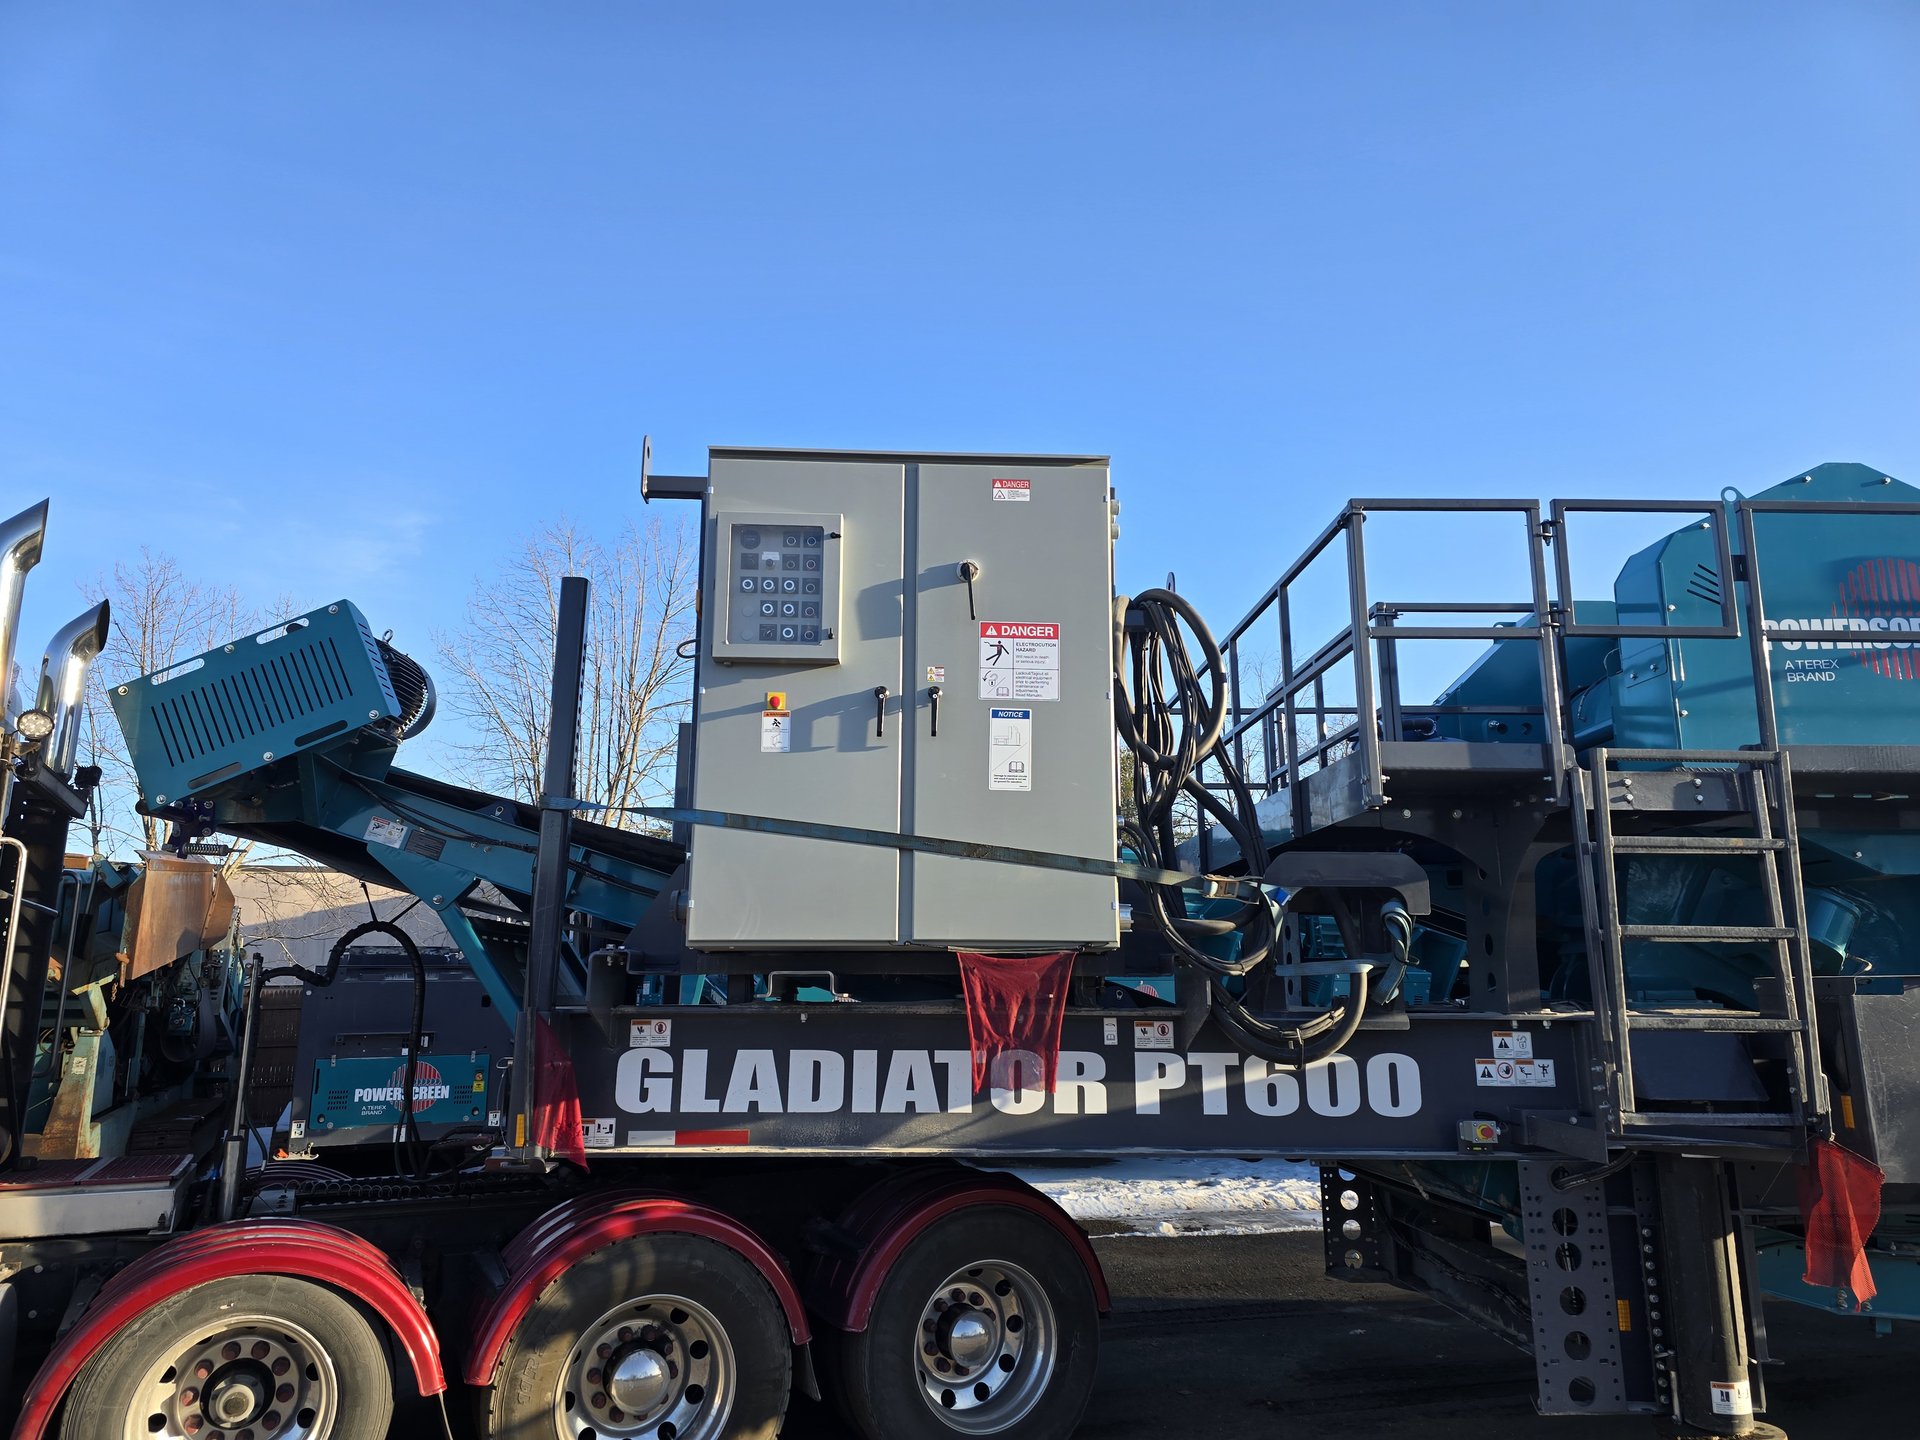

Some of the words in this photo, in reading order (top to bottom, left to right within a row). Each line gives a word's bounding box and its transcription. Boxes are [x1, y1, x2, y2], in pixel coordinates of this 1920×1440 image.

[1002, 480, 1030, 488] DANGER
[1001, 625, 1054, 637] DANGER
[1784, 660, 1794, 670] A
[1795, 659, 1840, 670] TEREX
[1786, 671, 1836, 683] BRAND
[615, 1047, 1108, 1115] GLADIATOR
[1134, 1051, 1423, 1118] PT600
